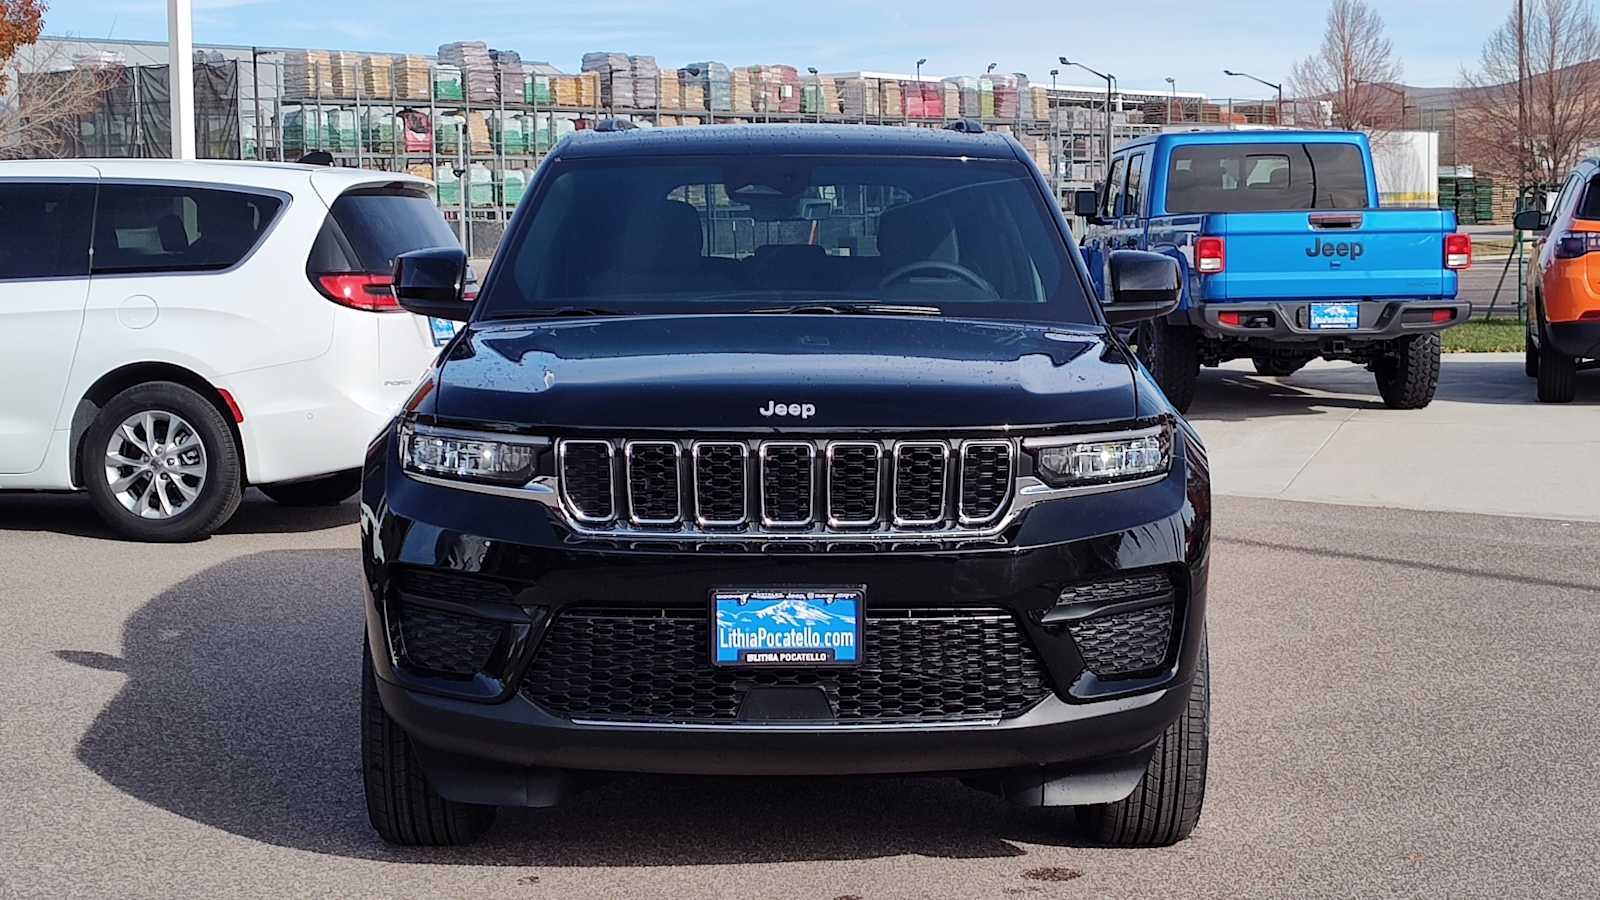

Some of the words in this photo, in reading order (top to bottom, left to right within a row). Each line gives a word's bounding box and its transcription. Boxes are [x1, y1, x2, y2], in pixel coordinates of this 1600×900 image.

[1305, 237, 1364, 261] Jeep
[759, 400, 816, 419] Jeep
[720, 627, 853, 648] LithiaPocatello.com
[780, 653, 826, 661] POCATELLO
